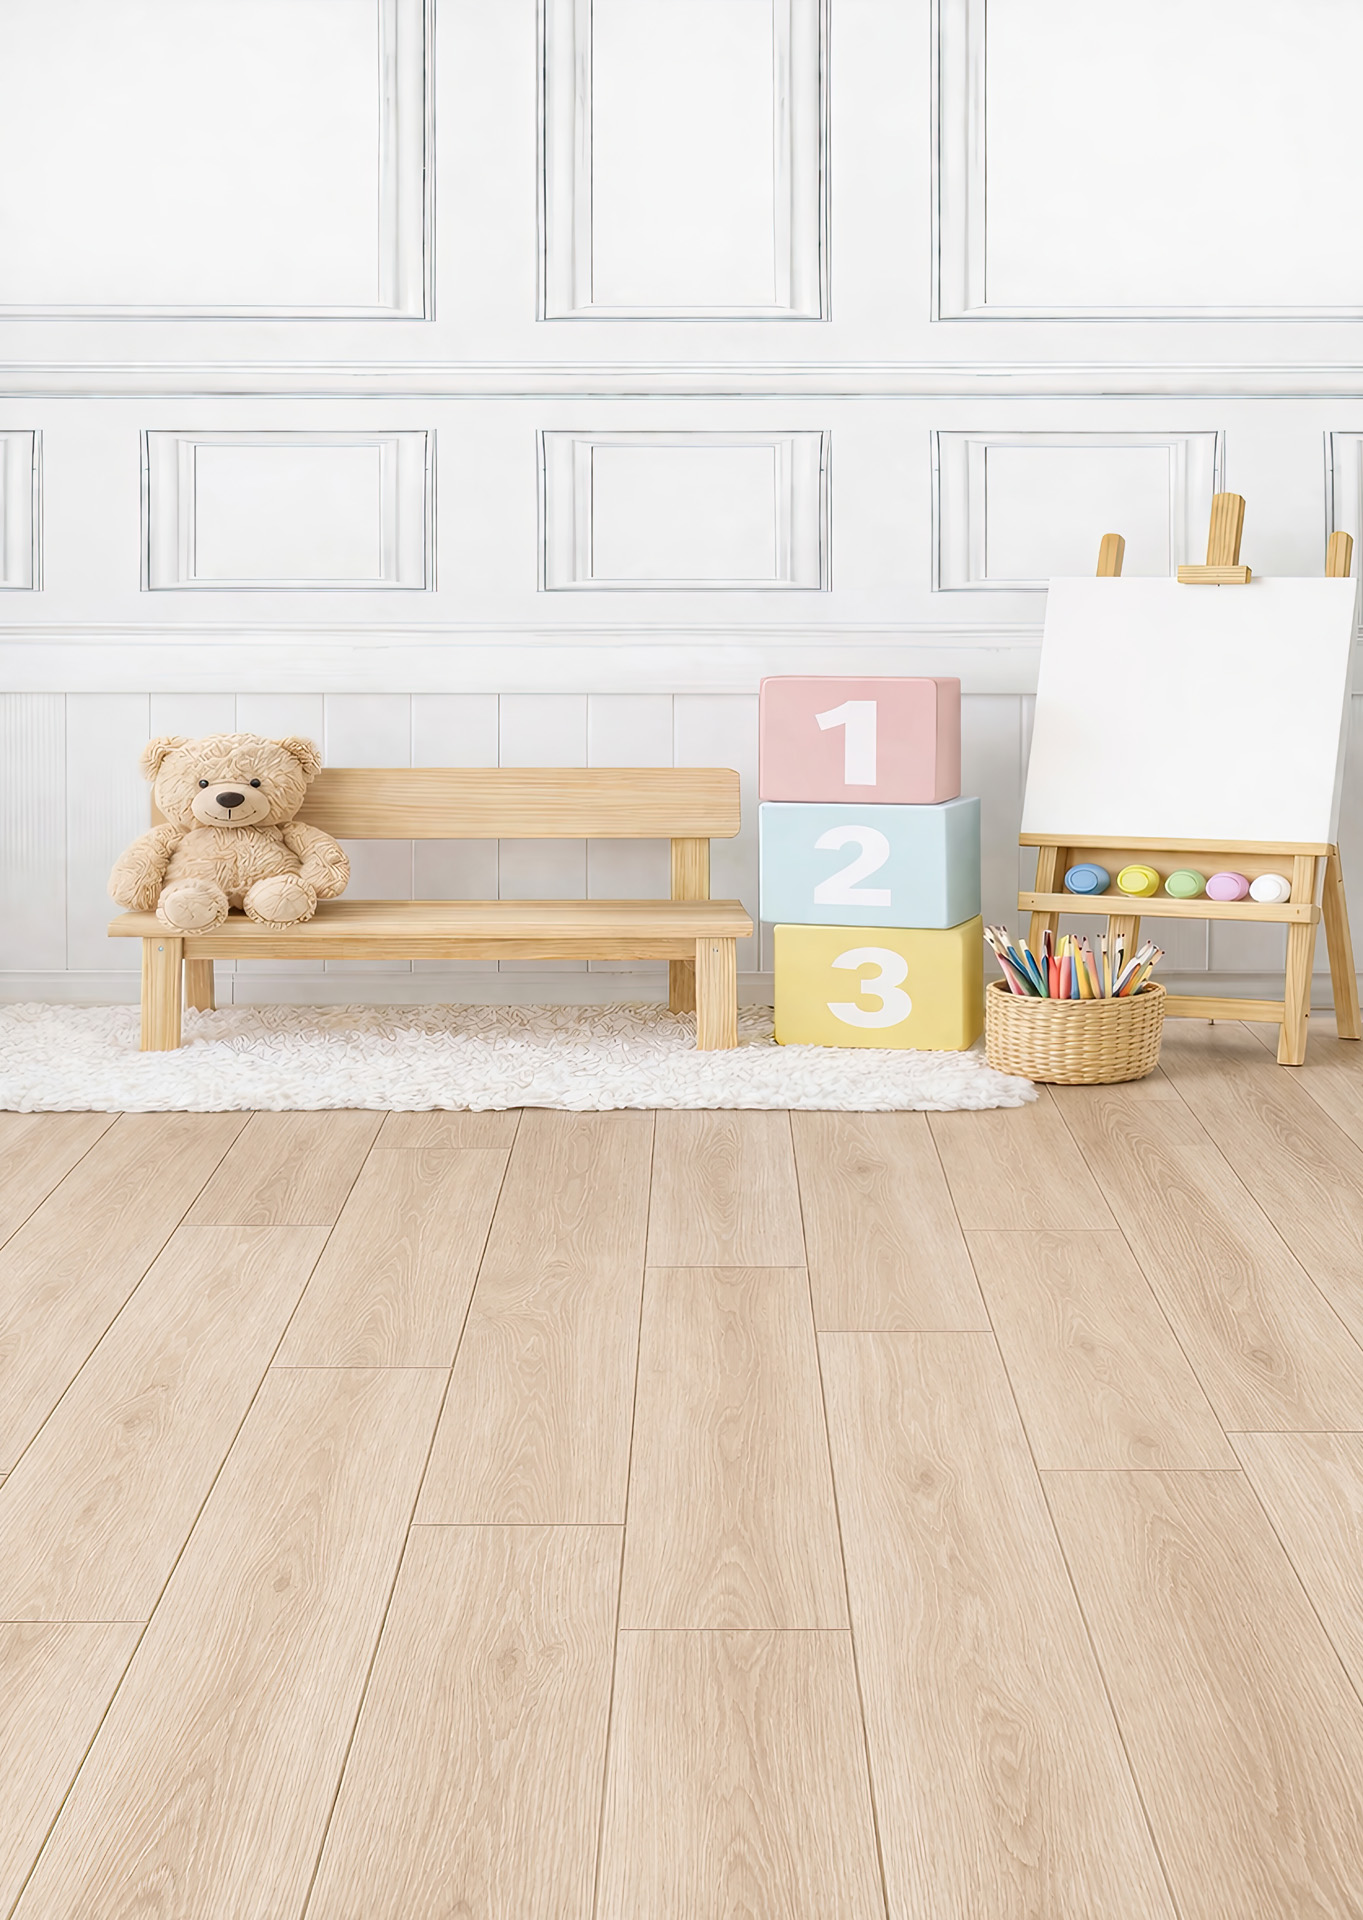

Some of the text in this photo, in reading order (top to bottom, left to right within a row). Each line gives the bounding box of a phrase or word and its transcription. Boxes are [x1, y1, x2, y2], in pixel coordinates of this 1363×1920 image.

[815, 700, 877, 786] 1
[813, 824, 892, 907] 2
[826, 946, 913, 1029] 3
